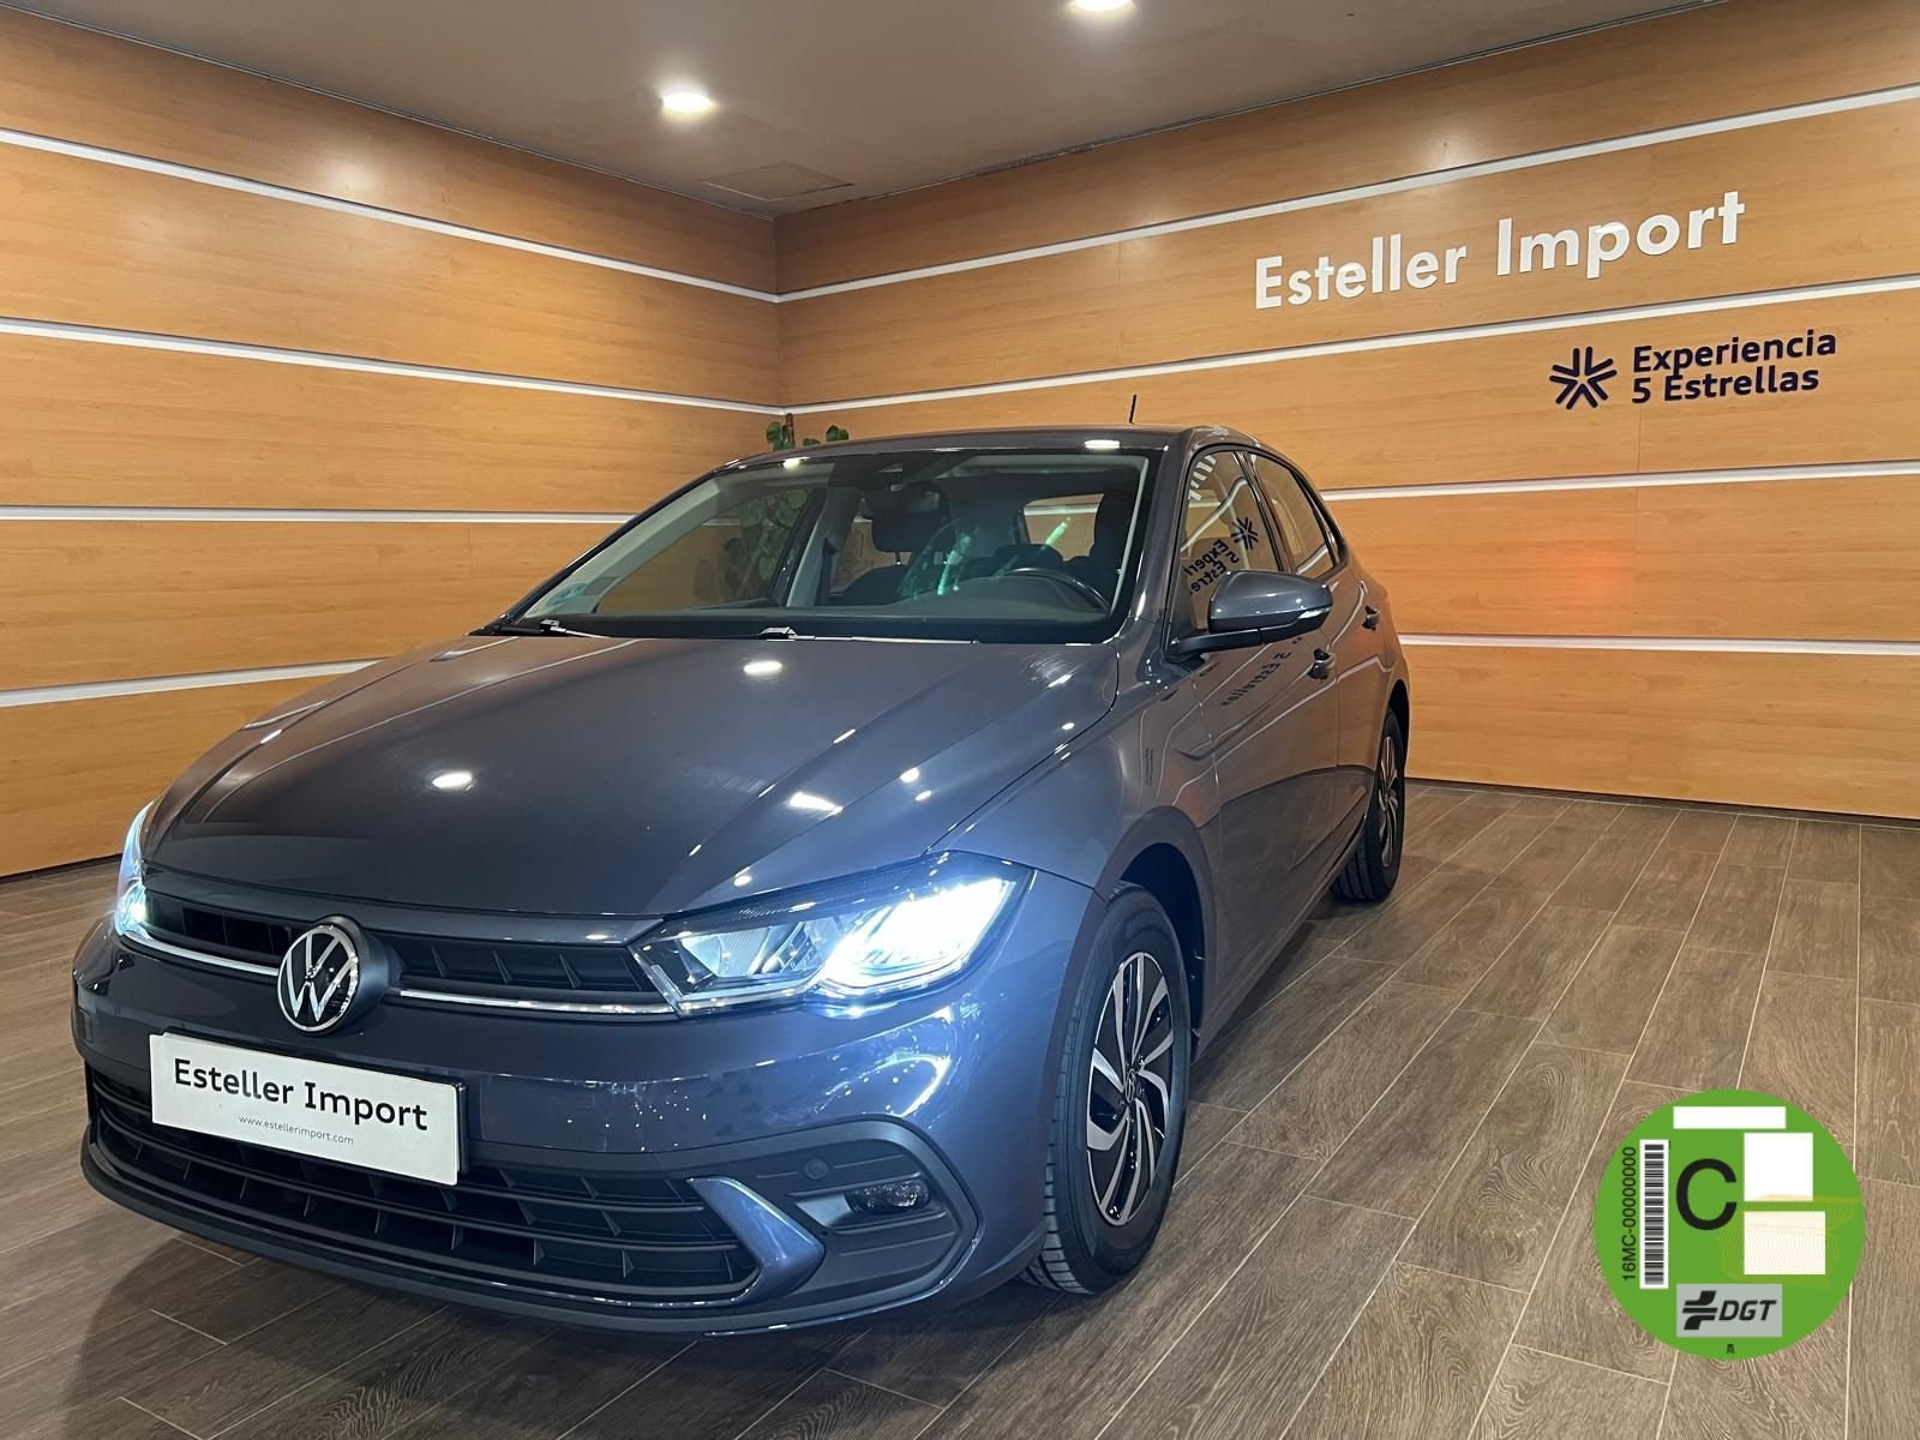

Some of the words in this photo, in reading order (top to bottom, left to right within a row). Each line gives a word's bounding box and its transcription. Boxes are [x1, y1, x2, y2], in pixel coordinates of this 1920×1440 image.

[1255, 233, 1467, 310] Esteller
[1497, 190, 1745, 279] Import
[1633, 328, 1837, 376] Experiencia
[1632, 377, 1651, 404] 5
[1664, 366, 1820, 402] Estrellas
[174, 1058, 294, 1104] Esteller
[304, 1081, 428, 1131] Import
[239, 1114, 354, 1144] www.estellerimport.com
